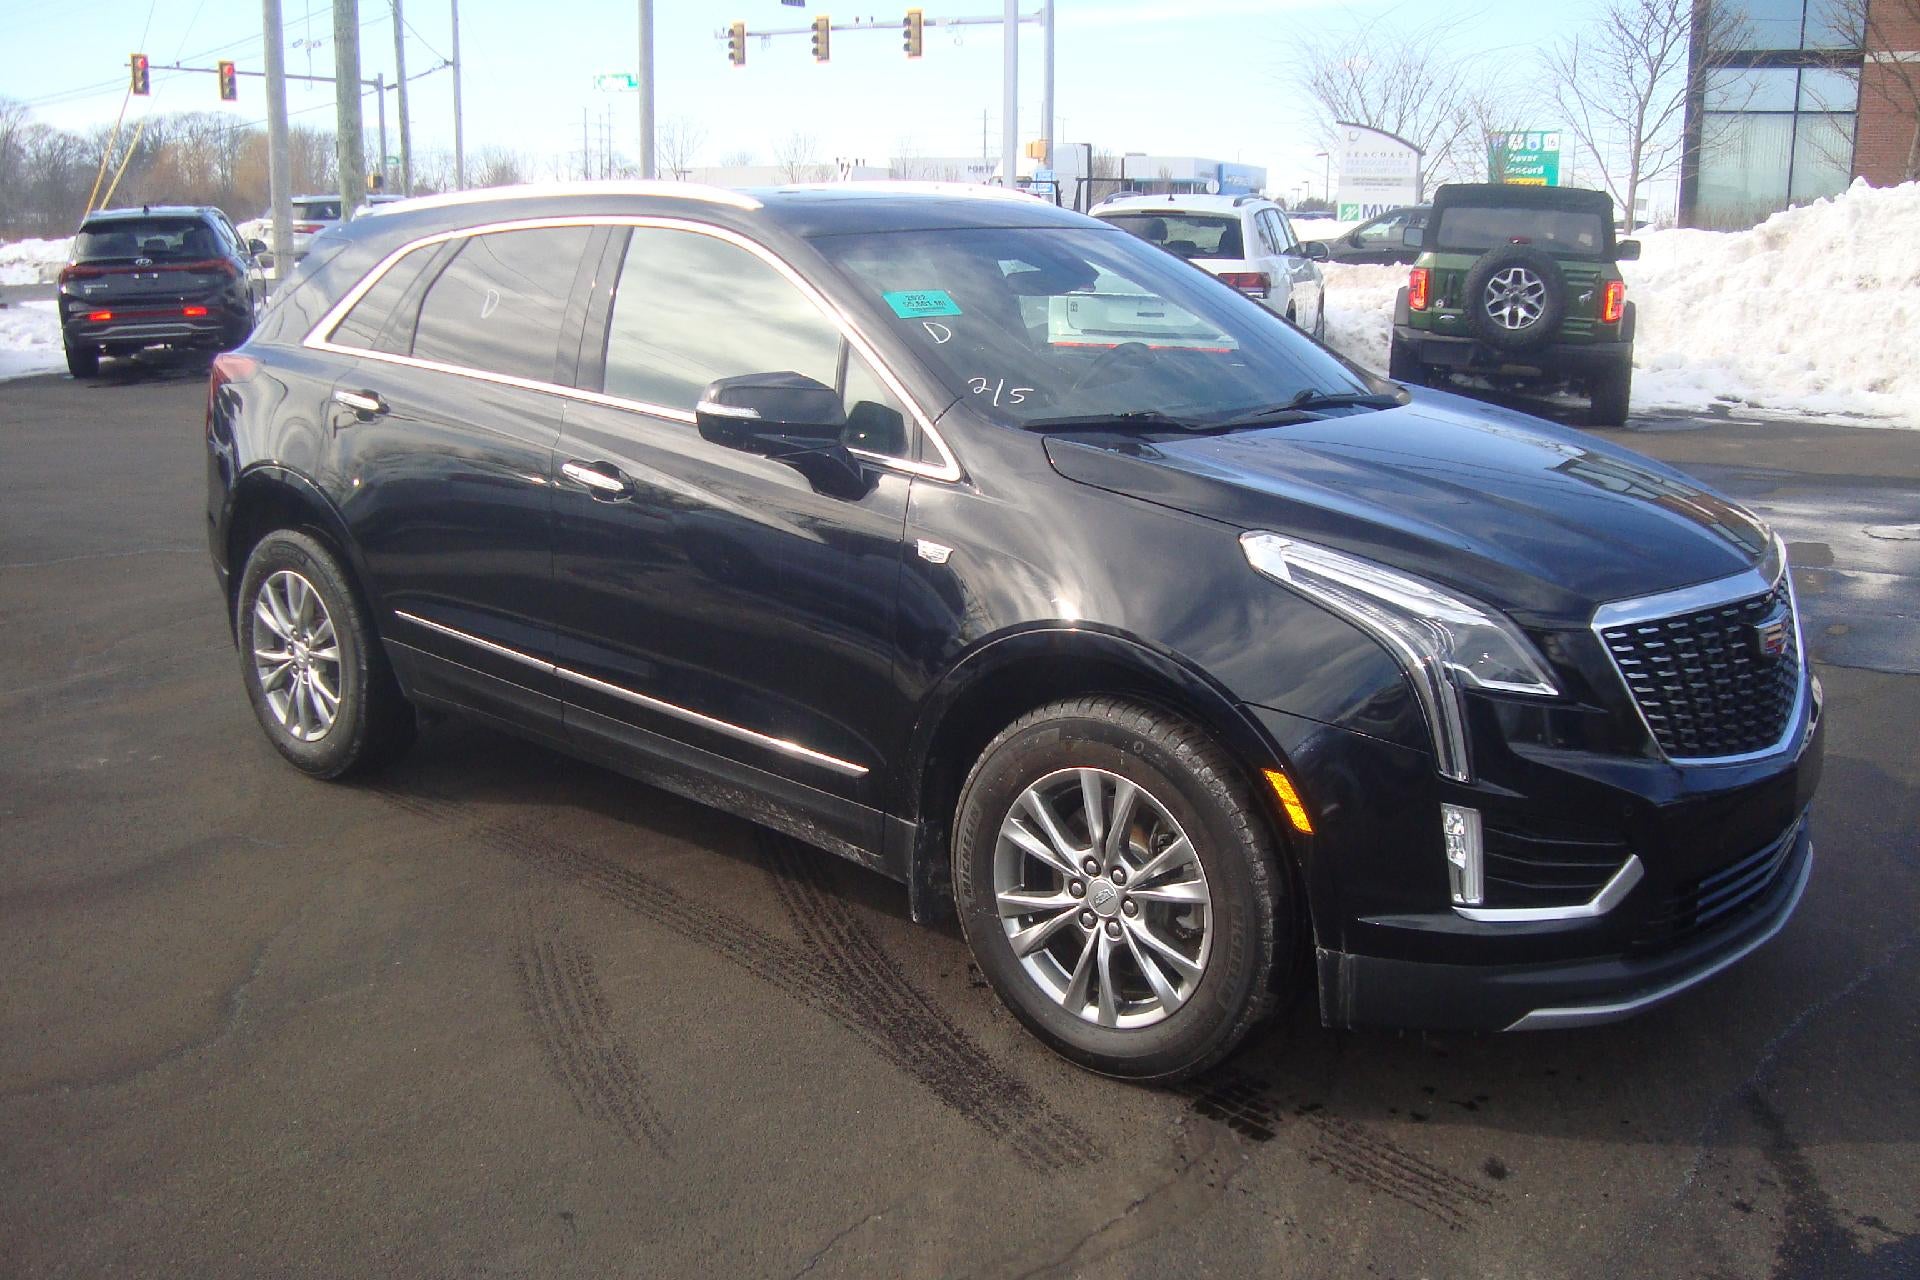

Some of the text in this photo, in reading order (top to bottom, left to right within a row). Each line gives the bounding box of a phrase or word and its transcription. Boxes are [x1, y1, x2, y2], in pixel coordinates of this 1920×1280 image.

[1362, 203, 1402, 219] MV
[480, 288, 500, 320] D
[922, 322, 952, 344] D
[967, 377, 1035, 407] 2/5
[963, 803, 982, 901] MICHELIN
